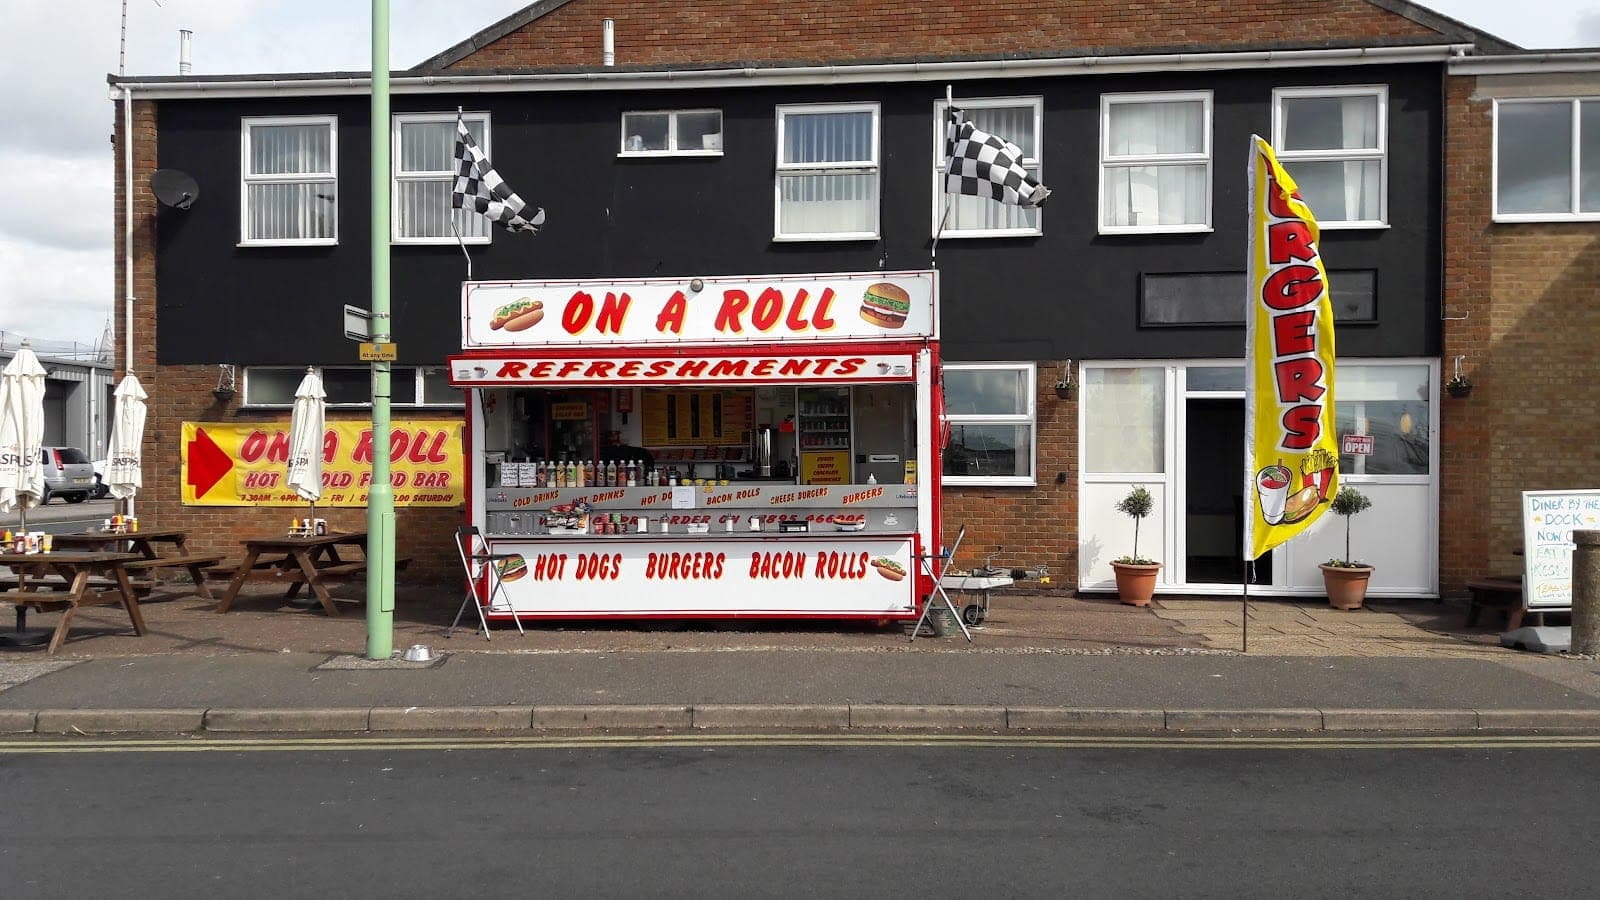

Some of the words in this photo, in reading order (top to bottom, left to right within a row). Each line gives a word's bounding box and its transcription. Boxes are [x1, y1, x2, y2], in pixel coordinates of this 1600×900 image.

[562, 290, 631, 334] ON
[656, 291, 687, 333] A
[715, 287, 835, 334] ROLL
[496, 358, 867, 379] REFRESHMENTS
[241, 431, 290, 463] ON
[353, 430, 447, 463] ROLL
[1345, 442, 1370, 454] OPEN
[245, 472, 280, 488] HOT
[322, 472, 355, 487] OLD
[359, 472, 407, 487] FD
[413, 472, 450, 488] BAR
[331, 494, 345, 502] FRI
[412, 493, 454, 502] SATURDAY
[513, 496, 531, 507] COLD
[533, 490, 559, 503] DRINKS
[592, 489, 625, 503] DRINKS
[640, 494, 657, 506] HOT
[706, 493, 733, 506] BACON
[736, 487, 761, 500] ROLLS
[770, 494, 795, 505] CHEESE
[797, 487, 829, 501] BURGERS
[842, 487, 884, 505] BURGERS
[1532, 499, 1564, 511] DINER
[1568, 499, 1581, 511] BY
[1545, 514, 1583, 525] DOCK
[1537, 530, 1563, 542] NOW
[534, 553, 568, 581] HOT
[575, 553, 623, 581] DOGS
[645, 552, 726, 580] BURGERS
[749, 551, 807, 580] BACON
[815, 551, 869, 580] ROLLS
